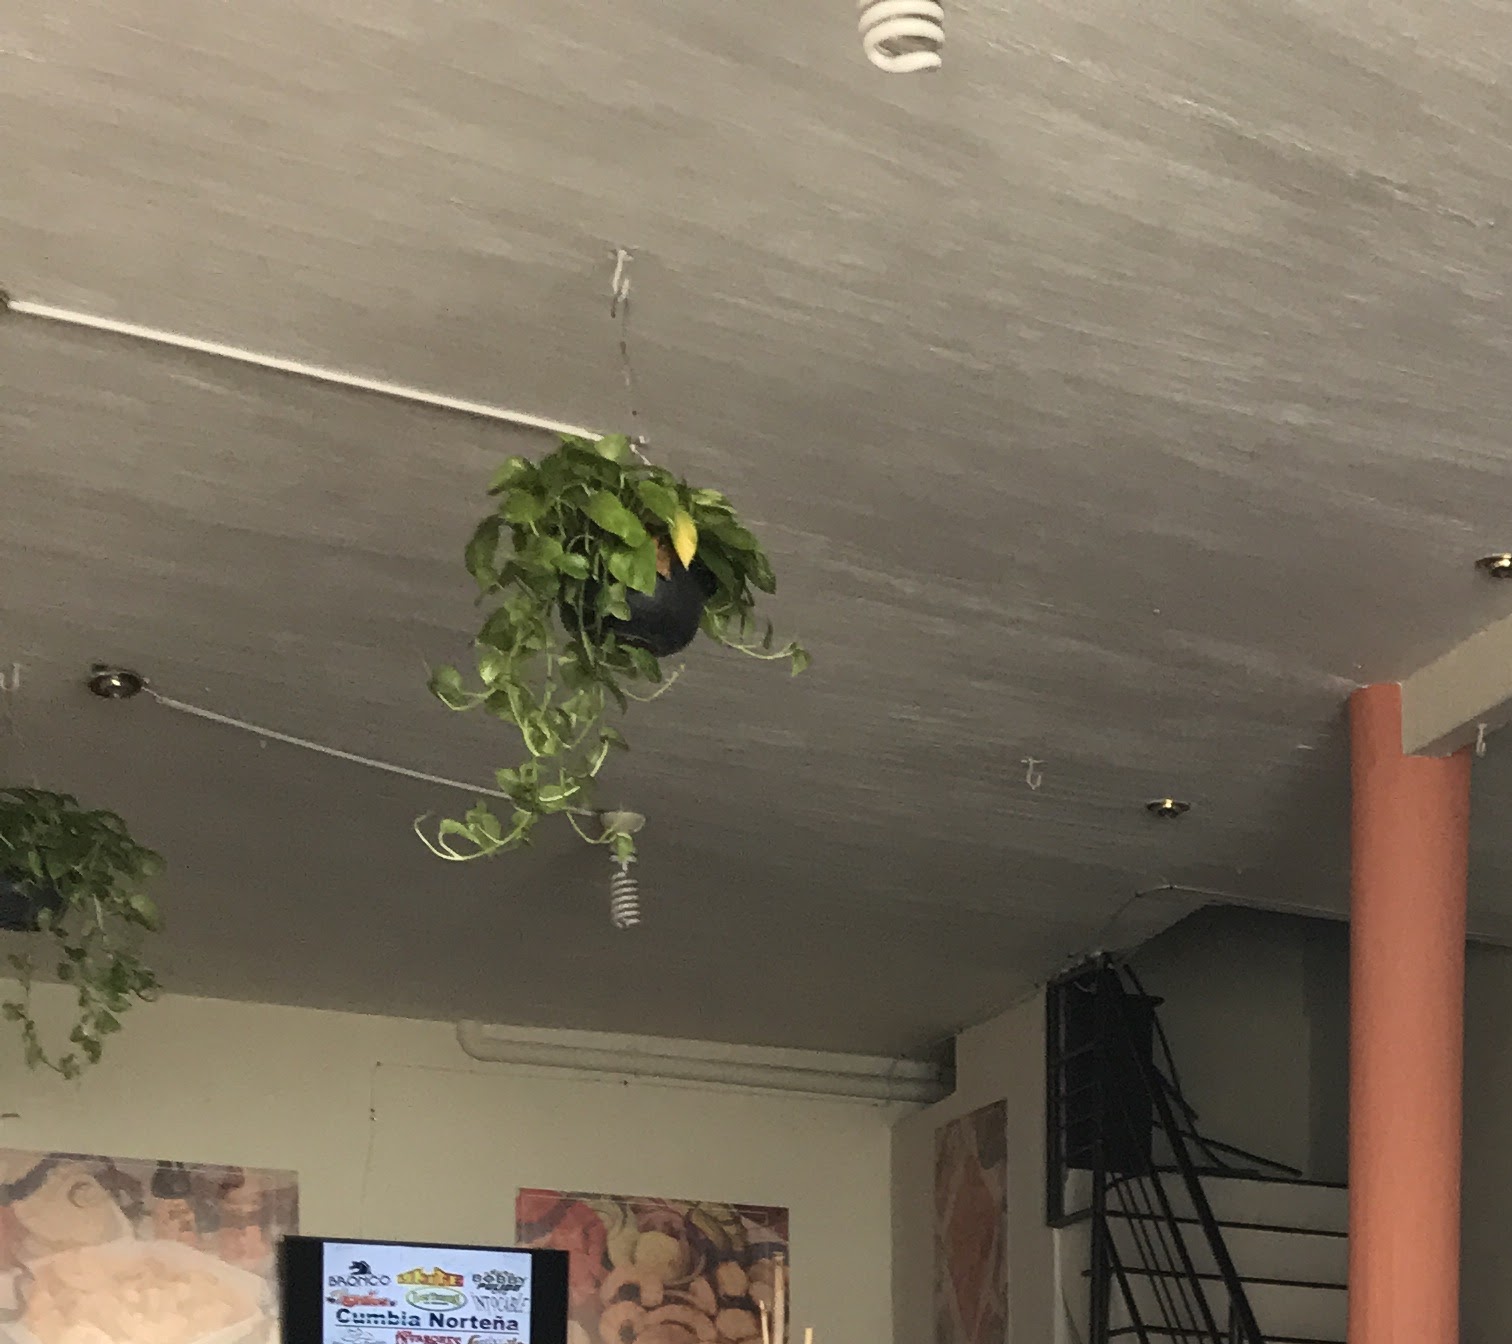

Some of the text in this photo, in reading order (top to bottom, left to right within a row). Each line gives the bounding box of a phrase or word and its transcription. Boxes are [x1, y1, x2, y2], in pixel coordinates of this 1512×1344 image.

[328, 1275, 391, 1287] BRONCO
[336, 1308, 519, 1332] Cumbia Norteña
